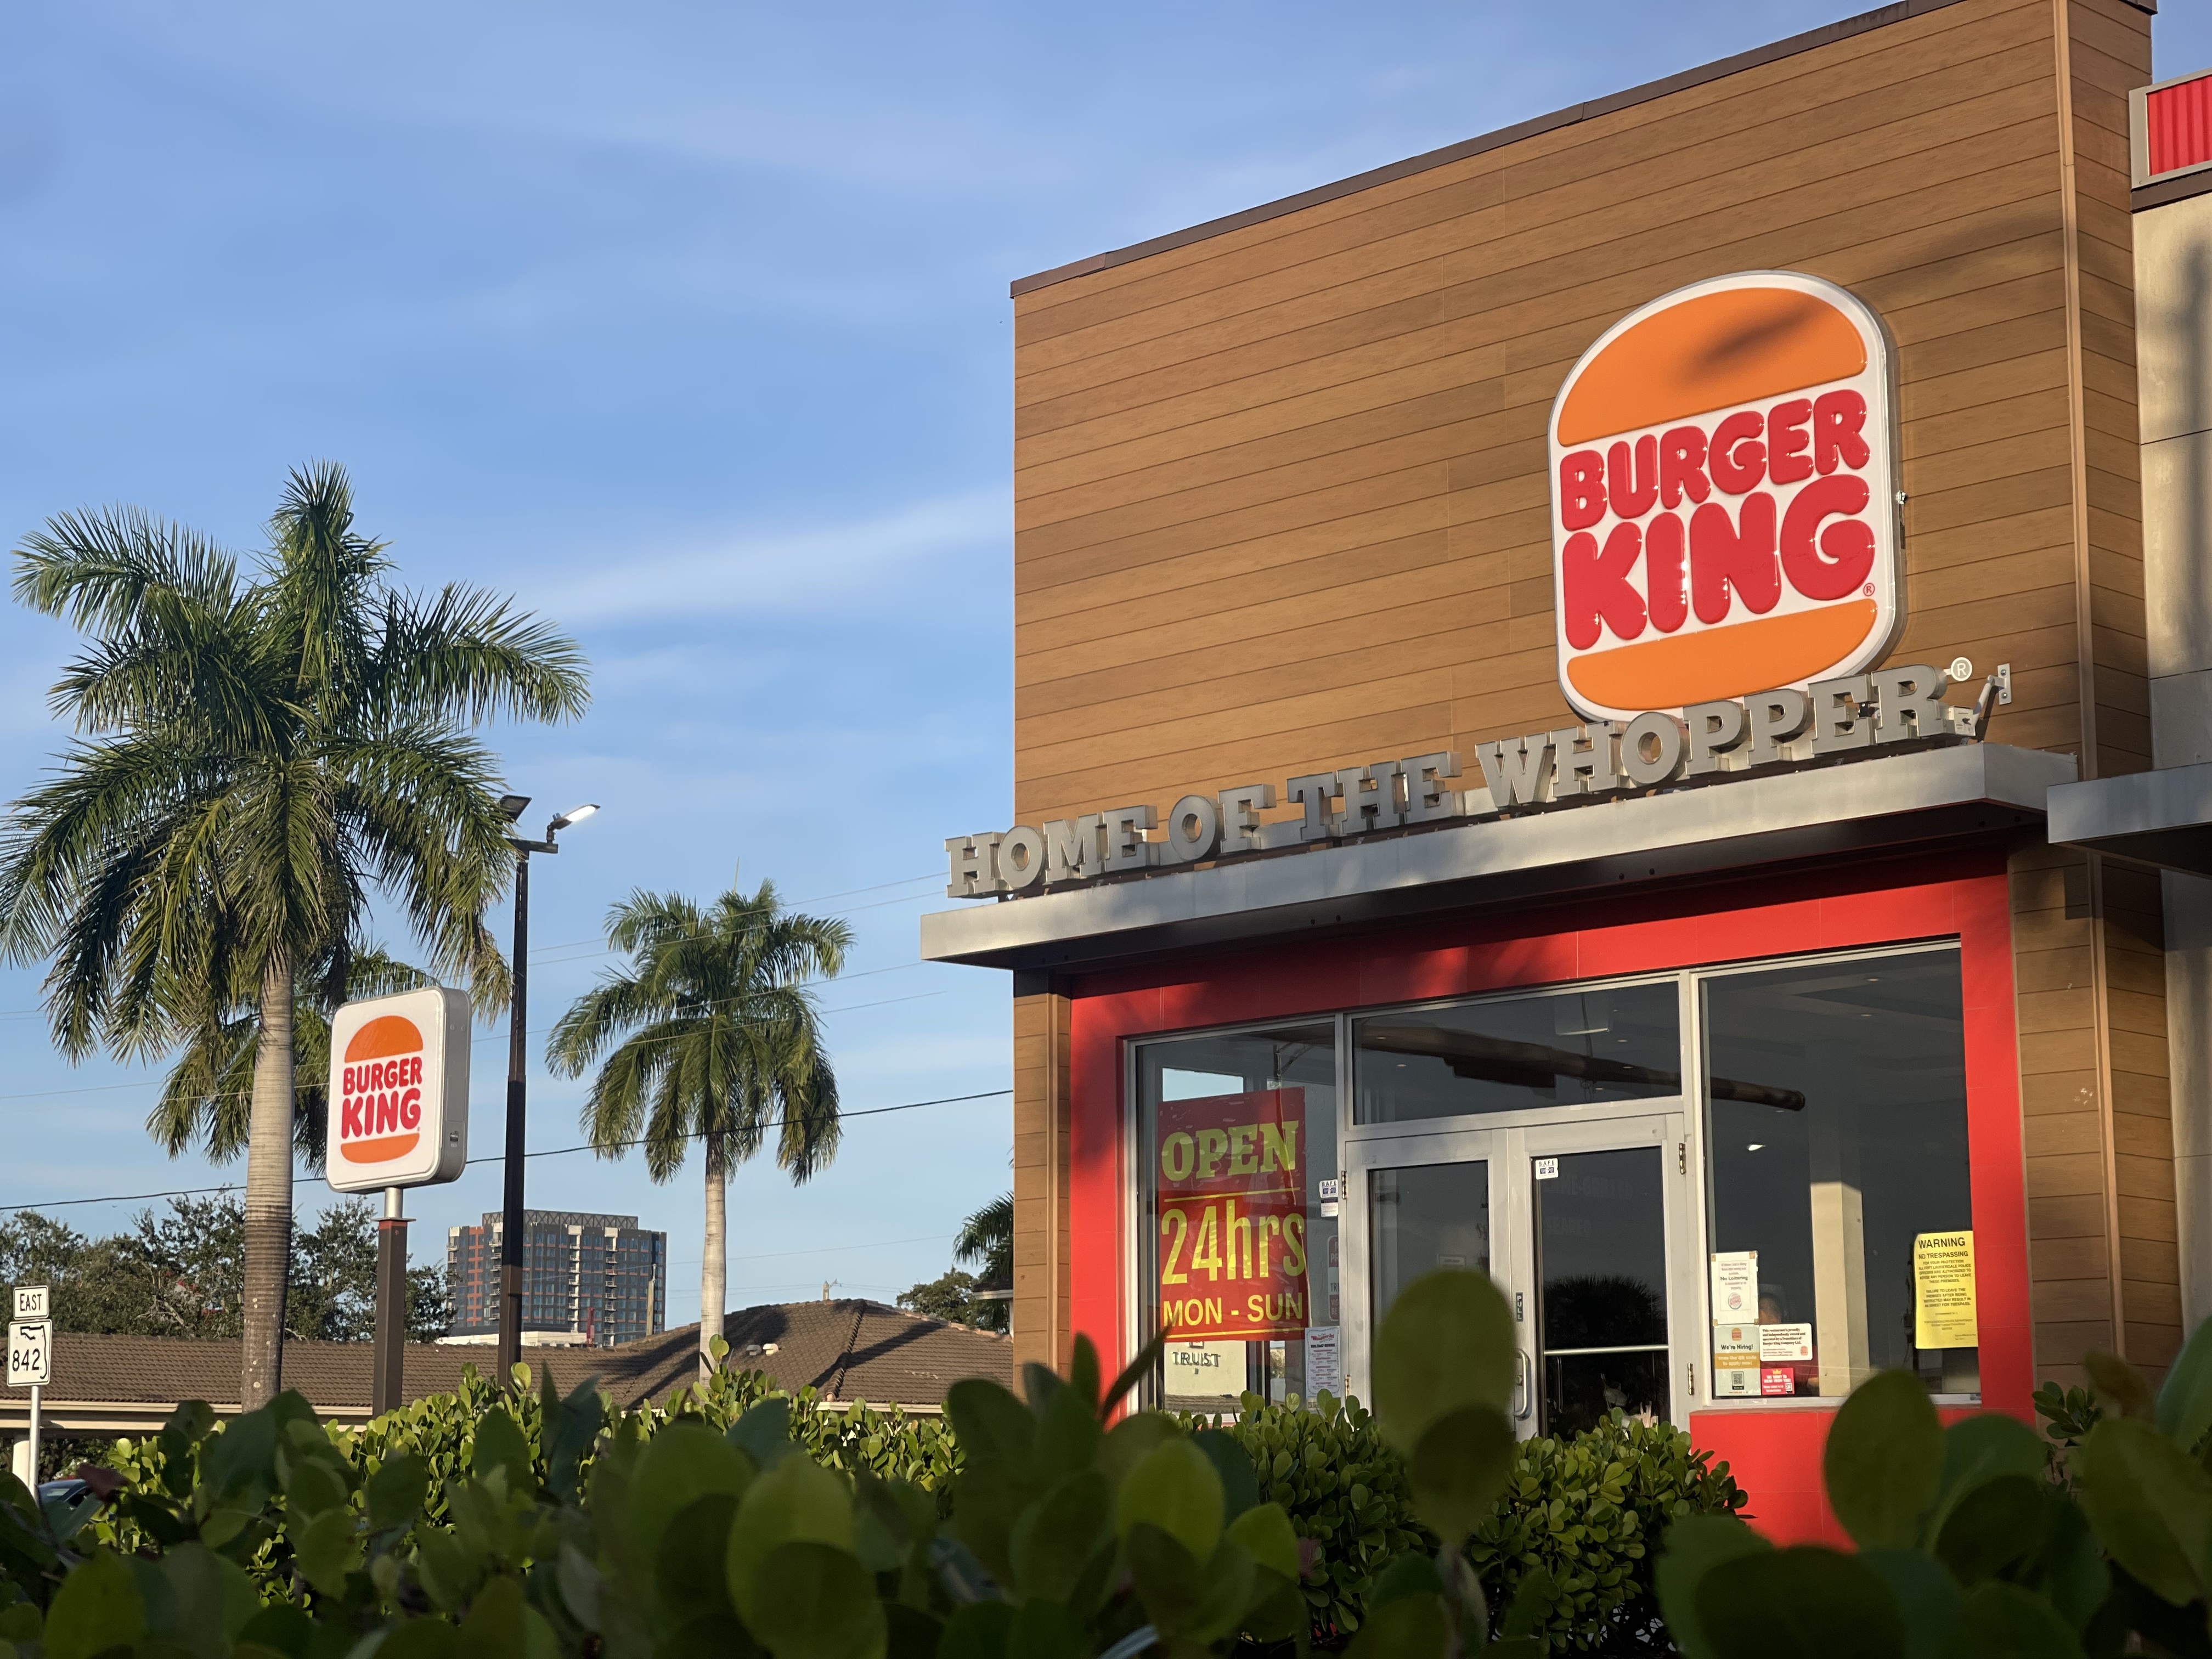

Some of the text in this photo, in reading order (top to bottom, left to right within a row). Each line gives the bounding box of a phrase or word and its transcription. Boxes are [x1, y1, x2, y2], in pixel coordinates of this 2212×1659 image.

[1560, 389, 1871, 531] BURGER
[1562, 473, 1875, 650] KING
[945, 805, 1158, 898] HOME
[1168, 783, 1277, 861] OF
[1287, 751, 1462, 842] THE
[343, 1056, 422, 1096] BURGER
[341, 1087, 421, 1139] KING
[1161, 1120, 1299, 1182] OPEN
[1161, 1200, 1305, 1285] 24hrs
[1918, 1237, 1965, 1249] WARNING
[1927, 1251, 1968, 1259] TRESPASSING
[20, 1294, 42, 1312] EAST
[1163, 1297, 1222, 1327] MON
[1248, 1292, 1303, 1322] SUN
[12, 1348, 41, 1372] 842
[1172, 1352, 1221, 1367] TRUST
